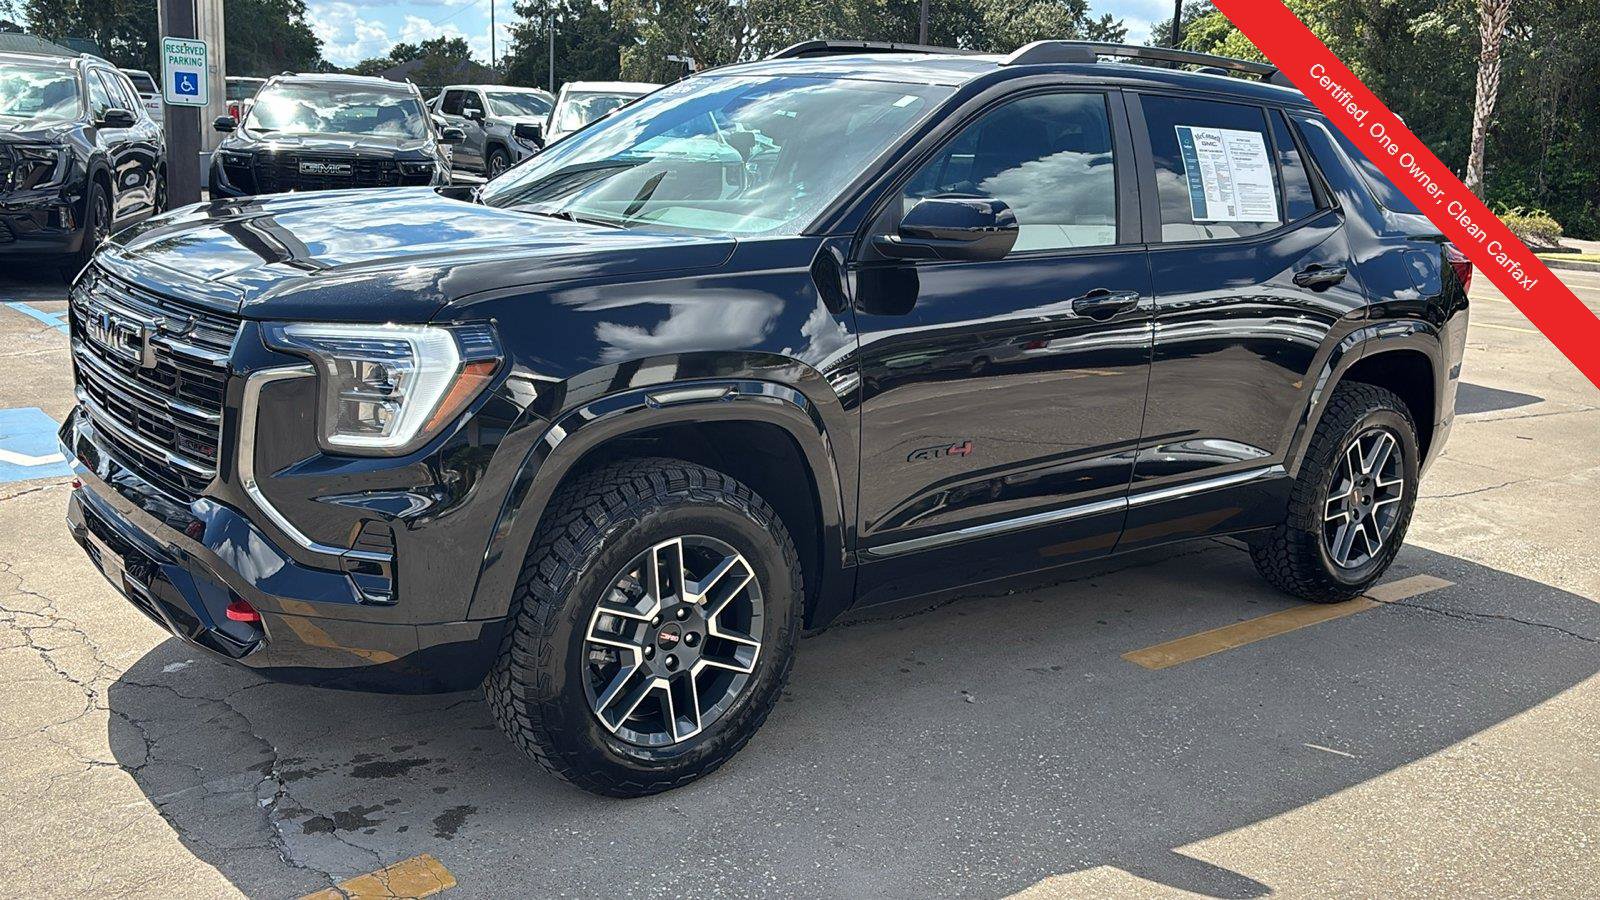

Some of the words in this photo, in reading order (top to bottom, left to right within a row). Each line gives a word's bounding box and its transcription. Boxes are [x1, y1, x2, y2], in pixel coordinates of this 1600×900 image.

[165, 44, 205, 55] RESERVED
[169, 55, 203, 67] PARKING
[301, 162, 352, 175] GMC
[86, 312, 142, 363] GMC
